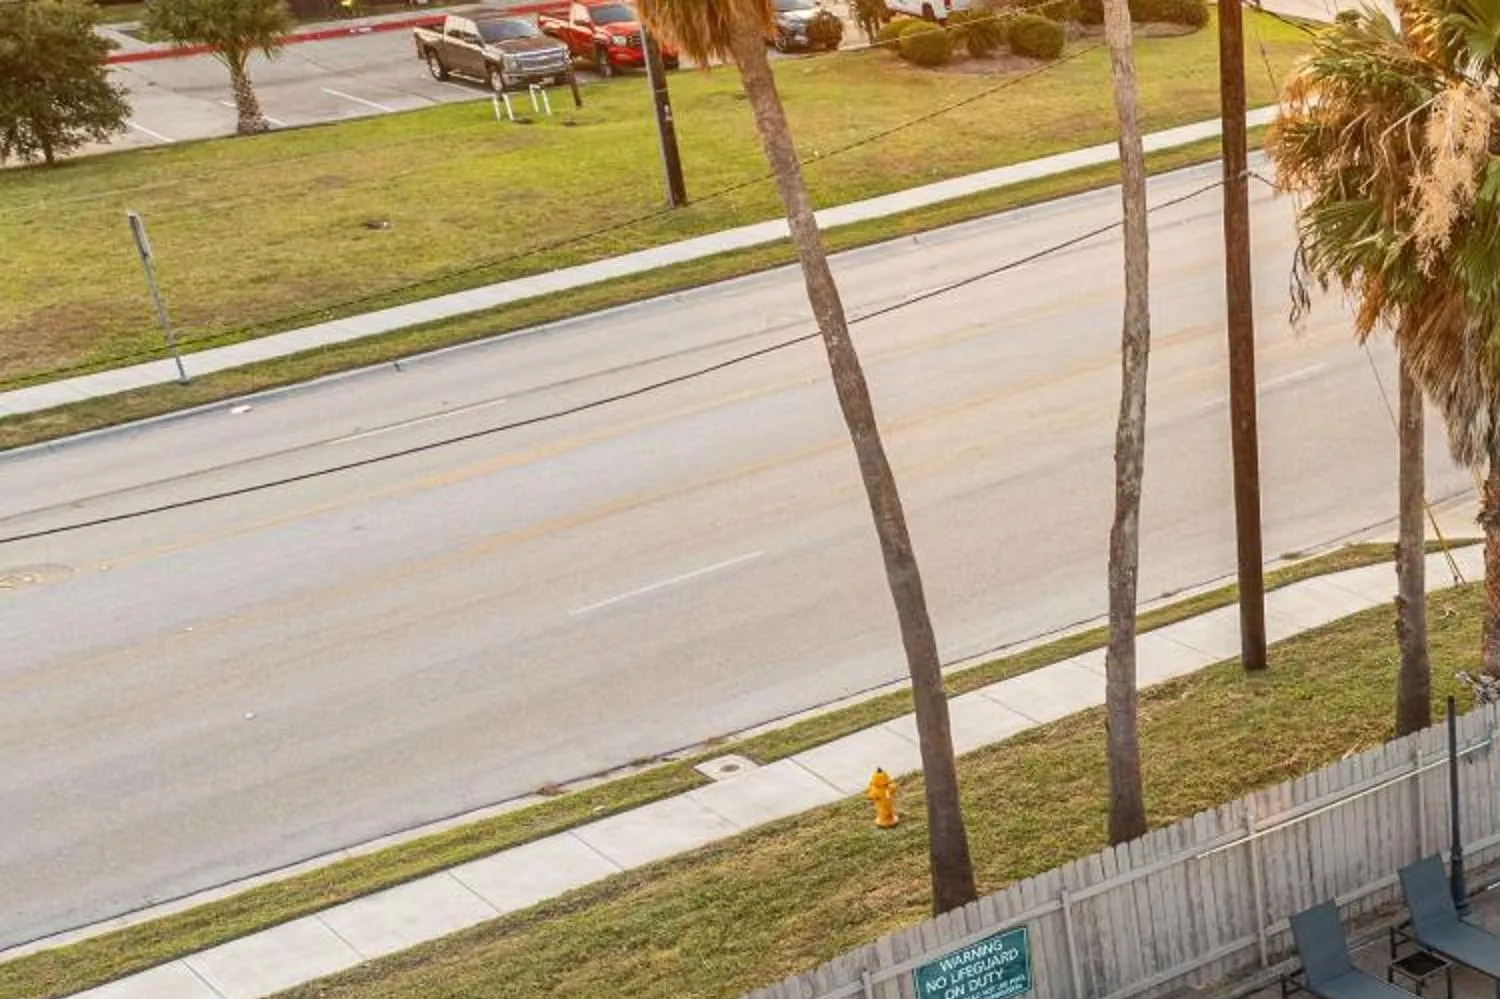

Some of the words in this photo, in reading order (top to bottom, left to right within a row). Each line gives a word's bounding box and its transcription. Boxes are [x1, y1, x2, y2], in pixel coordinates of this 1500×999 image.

[925, 976, 947, 994] NO
[950, 947, 1019, 985] LIFEGUARD
[940, 939, 1003, 972] WARNING
[967, 968, 1004, 992] DUTY
